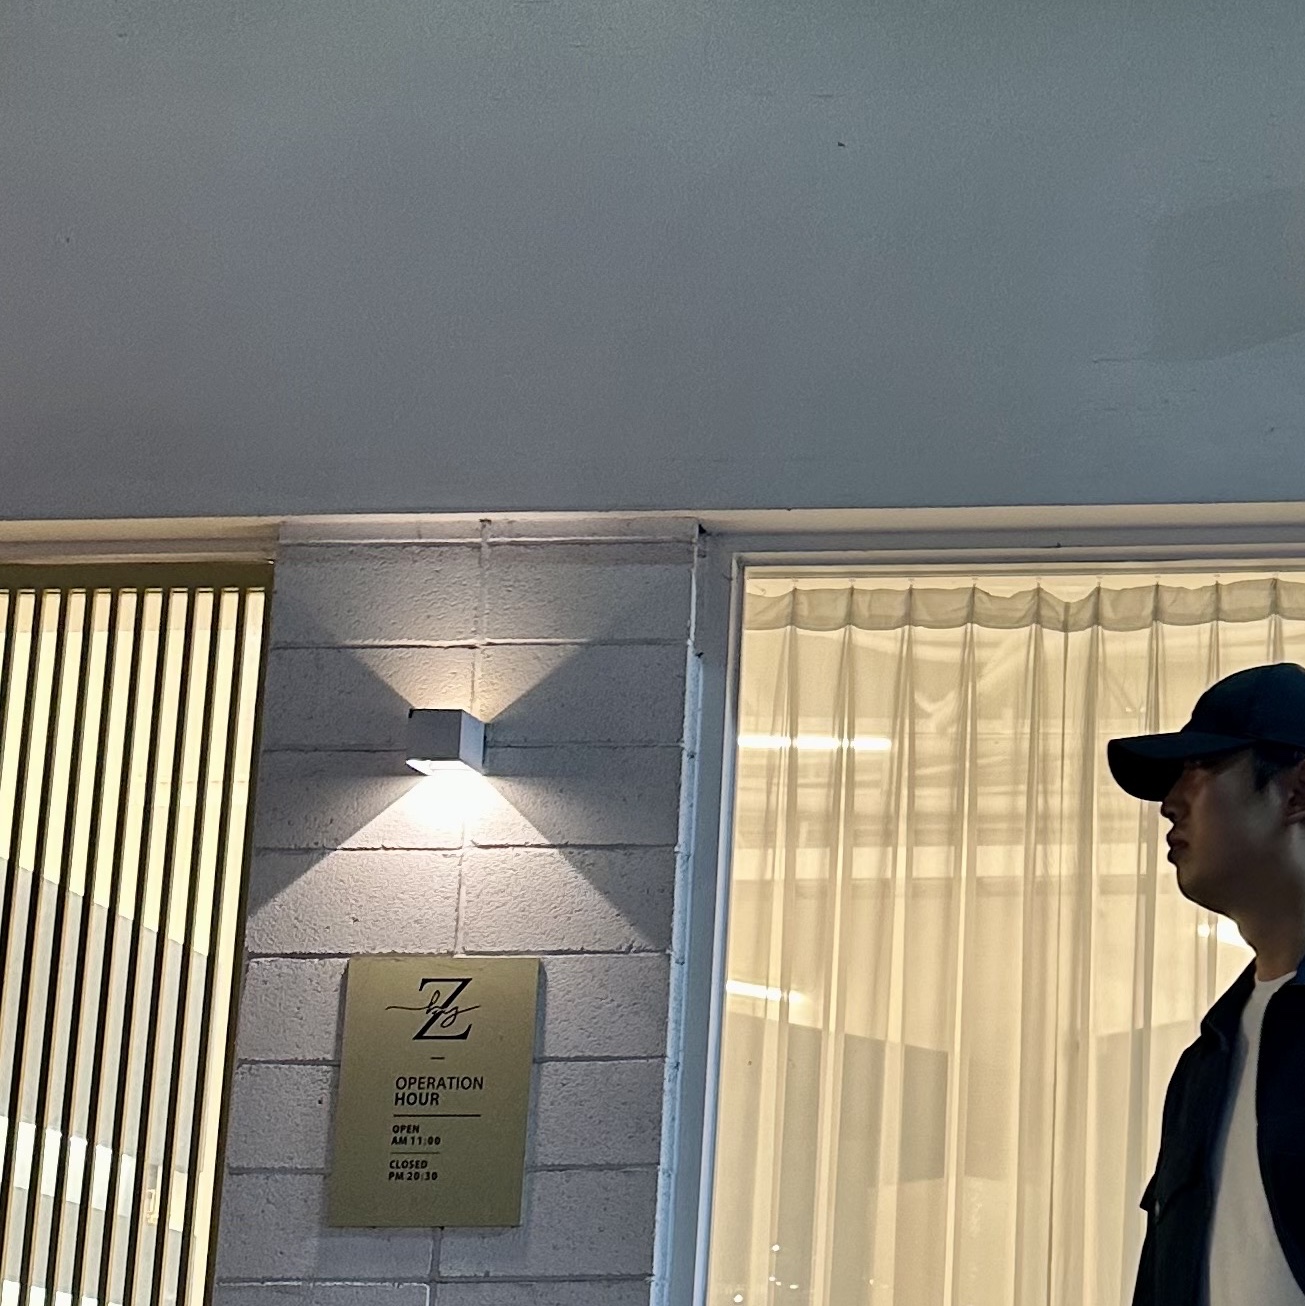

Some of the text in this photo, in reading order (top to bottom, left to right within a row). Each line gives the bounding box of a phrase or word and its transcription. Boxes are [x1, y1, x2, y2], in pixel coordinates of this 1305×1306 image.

[395, 1076, 484, 1090] OPERATION
[394, 1092, 440, 1106] HOUR
[392, 1124, 420, 1134] OPEN
[391, 1136, 441, 1146] AM 11:00
[389, 1160, 428, 1169] CLOSED
[388, 1171, 438, 1181] PM 20:30
